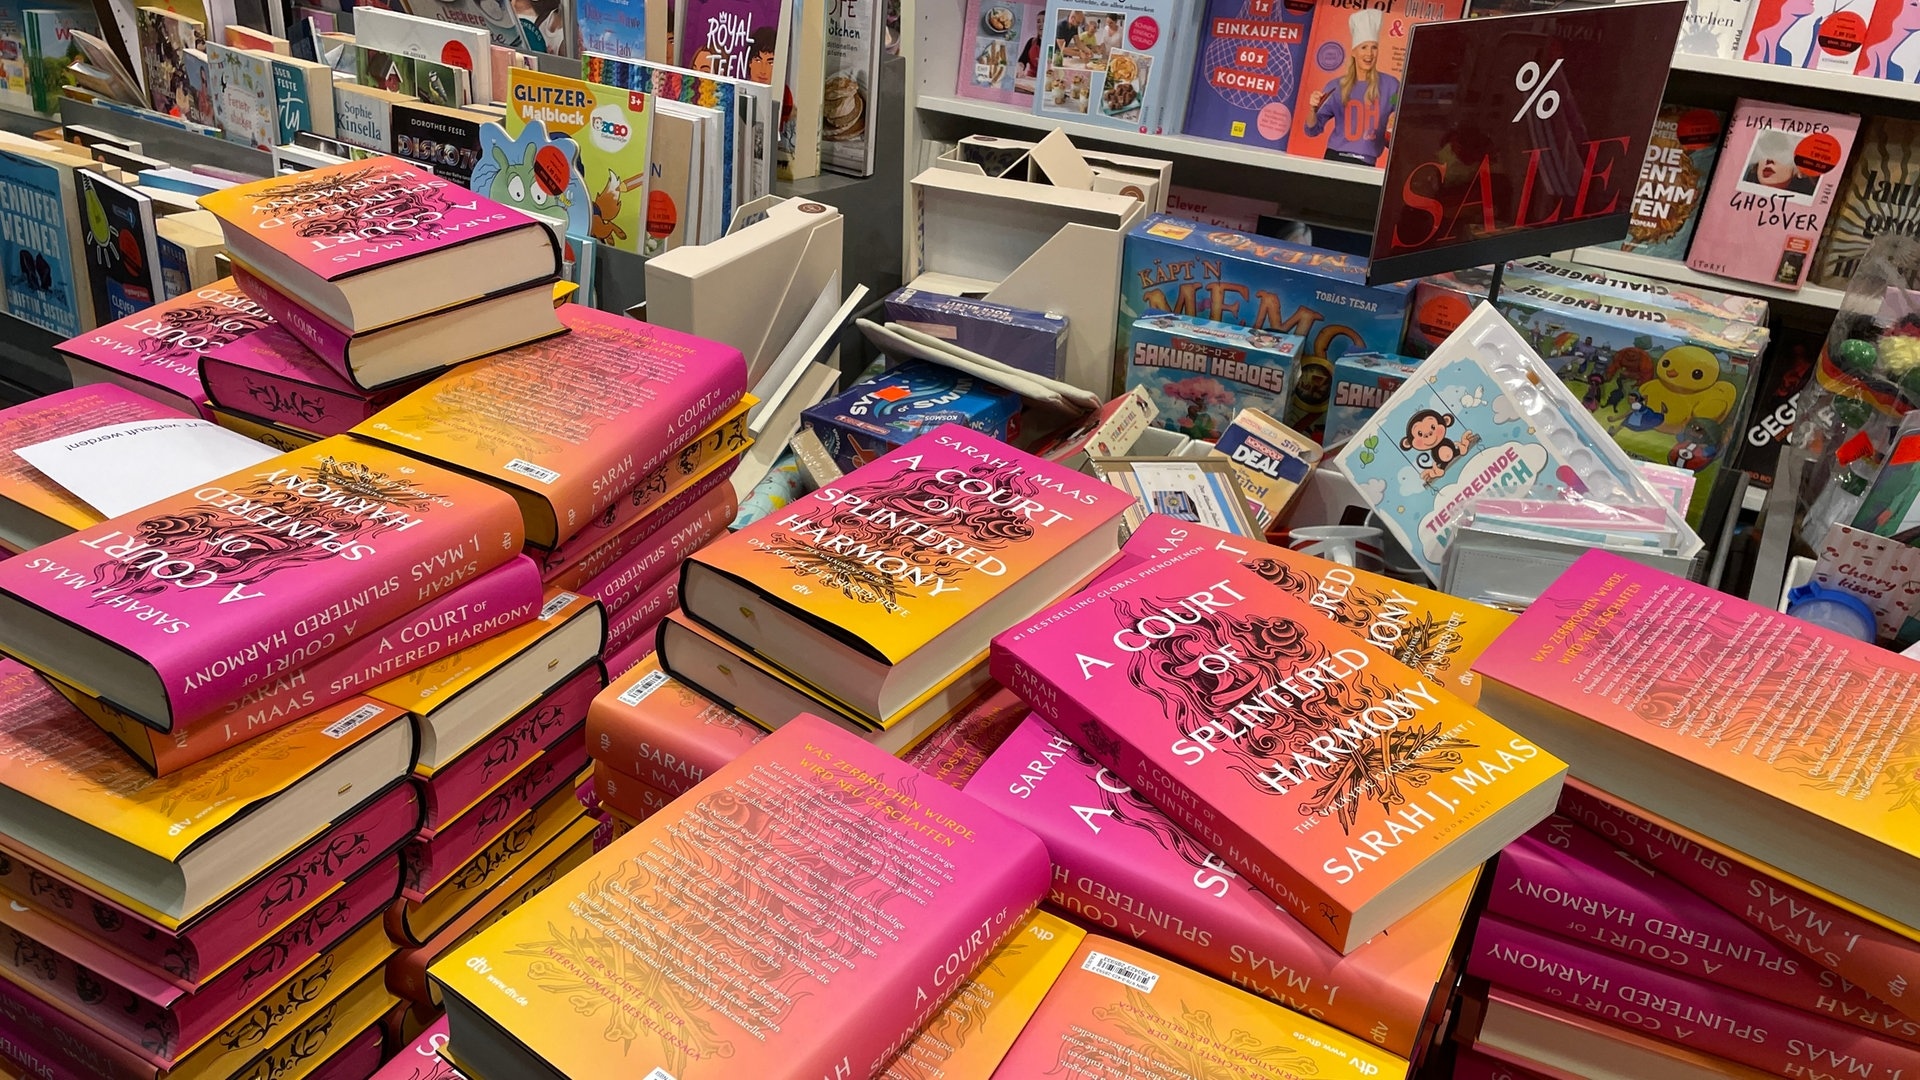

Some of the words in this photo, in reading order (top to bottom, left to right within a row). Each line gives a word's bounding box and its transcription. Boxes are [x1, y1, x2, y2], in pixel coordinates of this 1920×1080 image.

[1254, 1, 1268, 13] 1x
[1330, 0, 1371, 12] best
[1374, 0, 1394, 14] of
[1419, 4, 1445, 21] LALA
[1686, 12, 1735, 29] erchen
[707, 11, 755, 55] ROYAL
[1216, 22, 1299, 40] EINKAUFEN
[1731, 29, 1744, 53] PIPER
[705, 45, 750, 79] TEEN
[1239, 51, 1264, 65] 60x
[278, 79, 297, 92] FESTE
[514, 84, 593, 108] GLITZER-
[630, 94, 643, 106] 3+
[1216, 71, 1276, 93] KOCHEN
[1512, 58, 1562, 123] %
[336, 112, 382, 141] Kinsella
[344, 101, 373, 120] Sophie
[411, 118, 445, 134] DOROTHEE
[448, 124, 466, 137] FESEL
[521, 105, 584, 127] Malblock
[601, 119, 629, 138] BOBO
[1344, 98, 1381, 142] OH
[1746, 115, 1773, 130] LISA
[1779, 118, 1831, 135] TADDEO
[1650, 145, 1684, 164] DIE
[0, 180, 61, 229] ENNIFER
[1166, 194, 1208, 213] Clever
[1391, 135, 1631, 248] SALE
[1730, 191, 1796, 214] GHOST
[1818, 182, 1834, 206] PIPER
[1, 211, 61, 259] WEINER
[1629, 218, 1658, 230] ROMAN
[1757, 212, 1819, 233] LOVER
[1206, 231, 1350, 268] MEMO
[1138, 256, 1222, 289] KÄPT'N
[1523, 260, 1670, 297] CHALLENGERS!
[112, 293, 135, 315] CLEVER
[1315, 290, 1347, 307] TOBIAS
[1348, 297, 1379, 313] TESAR
[1514, 284, 1668, 324] CHALLENGERS!
[1142, 282, 1369, 358] MEMO
[89, 335, 144, 359] MAAS
[1179, 341, 1239, 361] サクラヒーローズ
[1133, 343, 1208, 375] SAKURA
[1210, 357, 1285, 394] HEROES
[912, 377, 974, 410] SWIM
[115, 421, 182, 442] verkauft
[642, 423, 698, 475] SPLINTERED
[699, 388, 744, 431] HARMONY
[924, 413, 959, 423] KOSMOS
[64, 428, 118, 452] werden!
[1246, 435, 1284, 463] MONOPOLY
[592, 453, 634, 497] SARAH
[1231, 445, 1281, 480] DEAL
[254, 468, 425, 532] HARMONY
[601, 472, 637, 506] MAAS
[891, 453, 926, 472] A
[934, 467, 1074, 528] COURT
[1424, 446, 1520, 535] TIERFREUNDE
[193, 487, 377, 562] SPLINTERED
[927, 496, 971, 519] OF
[670, 517, 704, 550] MAAS
[812, 486, 1008, 577] SPLINTERED
[79, 530, 219, 590] COURT
[604, 545, 666, 598] SPLINTERED
[747, 538, 773, 551] DAS
[773, 549, 810, 570] REICH
[775, 513, 962, 599] HARMONY
[217, 582, 267, 605] A
[418, 561, 478, 600] SARAH
[791, 582, 815, 596] dtv
[1026, 597, 1095, 636] BESTSELLING
[1095, 576, 1139, 603] GLOBAL
[1138, 544, 1205, 581] PHENOMENON
[1837, 577, 1884, 600] kisses
[1838, 563, 1898, 593] Cherry
[293, 575, 401, 638] SPLINTERED
[1074, 651, 1114, 680] A
[1112, 579, 1249, 651] COURT
[183, 629, 289, 695] HARMONY
[330, 640, 441, 696] SPLINTERED
[446, 602, 534, 648] HARMONY
[1198, 644, 1239, 676] OF
[1012, 662, 1060, 702] SARAH
[1169, 648, 1371, 766] SPLINTERED
[1256, 681, 1434, 797] HARMONY
[638, 741, 703, 783] SARAH
[1008, 735, 1073, 800] SARAH
[1292, 815, 1320, 836] THE
[1411, 722, 1470, 760] MOVEMENT
[796, 757, 837, 781] WIRD
[832, 778, 866, 798] NEU
[862, 794, 957, 848] GESCHAFFEN
[1068, 802, 1116, 836] A
[1322, 802, 1437, 886] SARAH
[1426, 789, 1461, 816] J.
[1450, 738, 1539, 796] MAAS
[1432, 799, 1494, 843] BLOOMSBURY
[1136, 773, 1224, 849] SPLINTERED
[1228, 845, 1312, 915] HARMONY
[1076, 876, 1213, 948] SPLINTERED
[1508, 876, 1636, 927] HARMONY
[564, 901, 586, 916] Weg
[603, 927, 622, 940] ihre
[617, 937, 663, 969] zerbrochene
[658, 965, 700, 994] Harmonie
[1644, 918, 1800, 977] SPLINTERED
[1746, 903, 1842, 969] SARAH
[1229, 944, 1313, 995] MAAS
[1486, 942, 1610, 994] HARMONY
[540, 946, 624, 1005] INTERNATIONALEN
[620, 1002, 704, 1061] BESTSELLERSAGA
[583, 955, 606, 971] DER
[603, 969, 645, 999] SECHSTE
[642, 996, 666, 1013] TEIL
[662, 1011, 686, 1028] DER
[1322, 982, 1341, 1006] J.
[1369, 1020, 1390, 1045] dtv
[1617, 984, 1769, 1045] SPLINTERED
